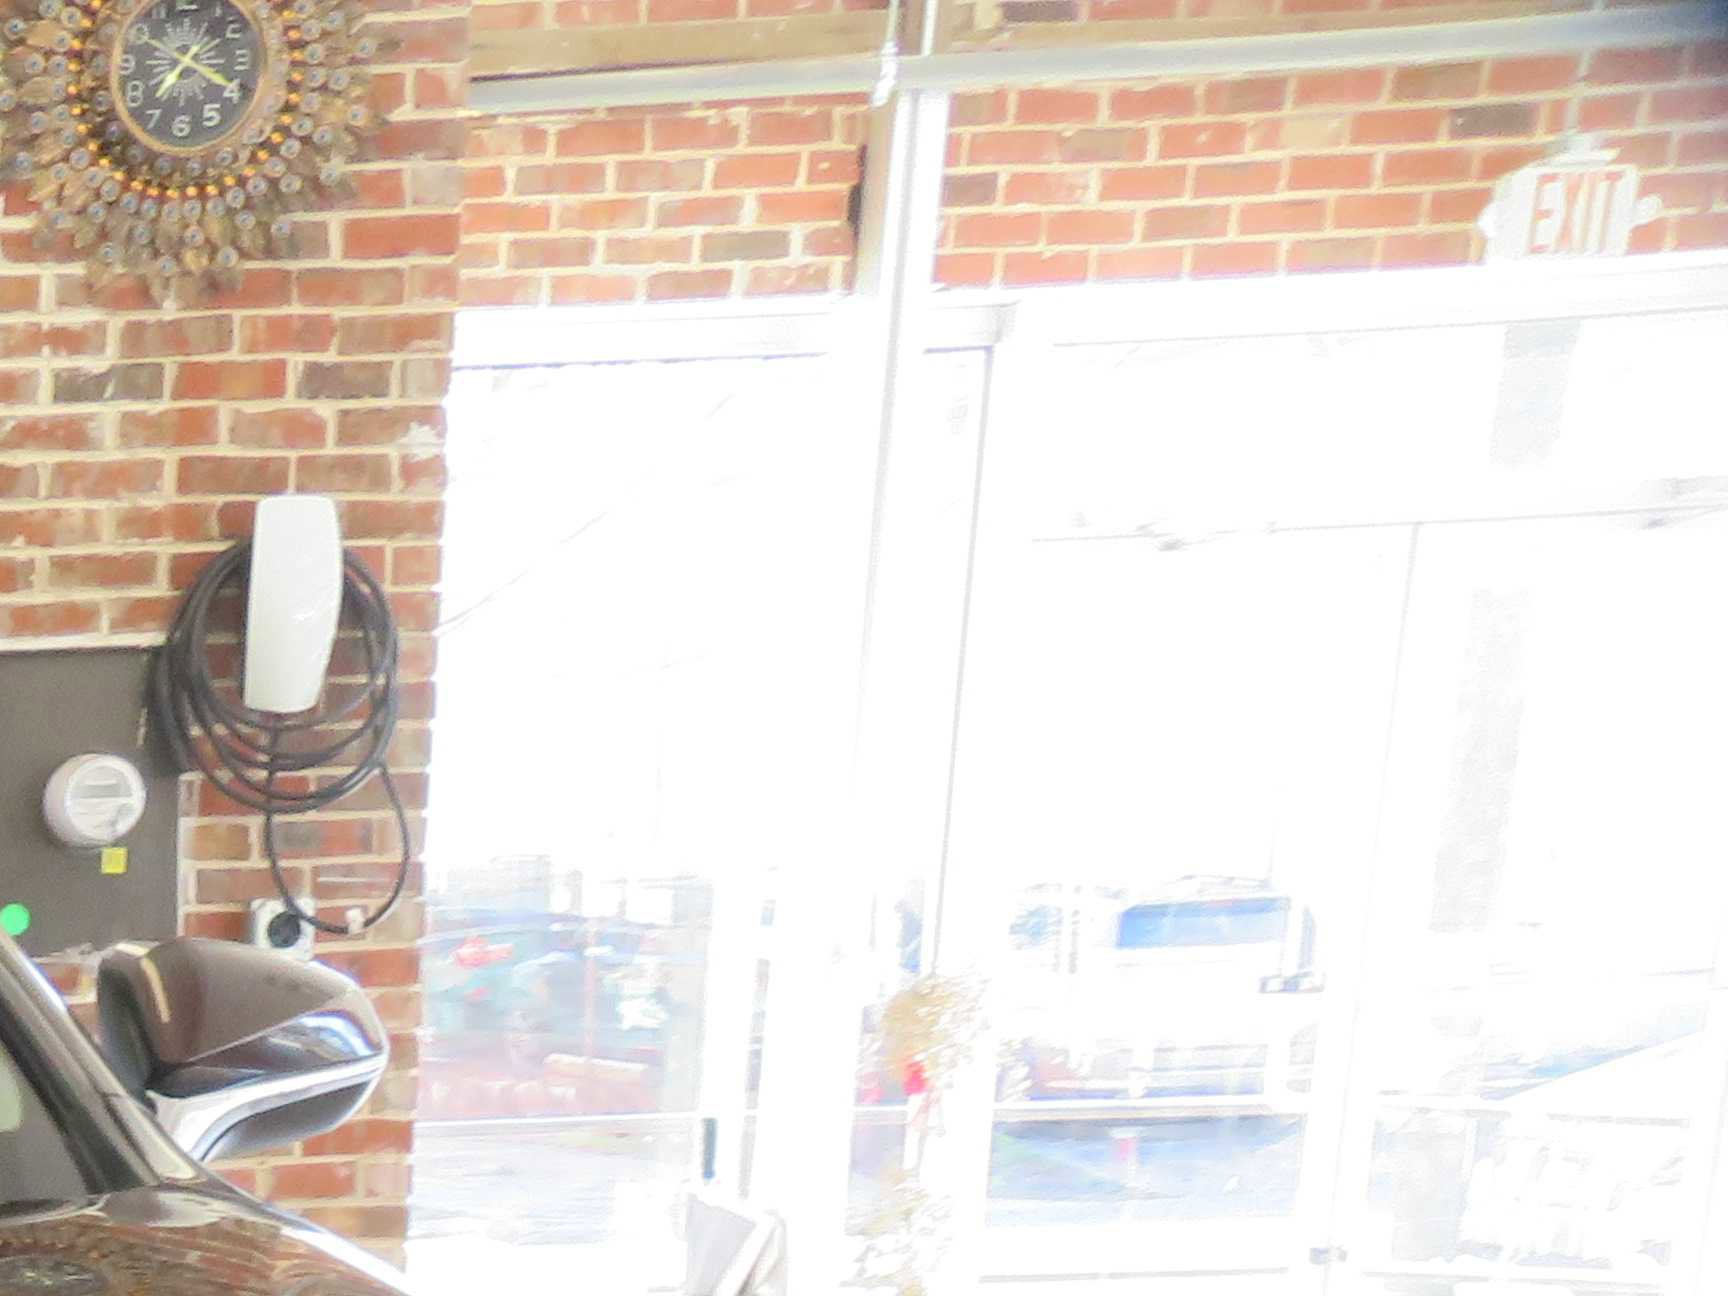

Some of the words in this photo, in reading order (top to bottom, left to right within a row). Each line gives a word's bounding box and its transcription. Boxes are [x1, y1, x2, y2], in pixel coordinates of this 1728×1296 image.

[120, 54, 135, 75] 9
[234, 50, 249, 71] 3
[127, 80, 144, 107] 8
[223, 79, 241, 104] 4
[146, 109, 162, 129] 7
[172, 115, 191, 137] 6
[202, 104, 221, 127] 5
[1526, 170, 1625, 254] EXIT
